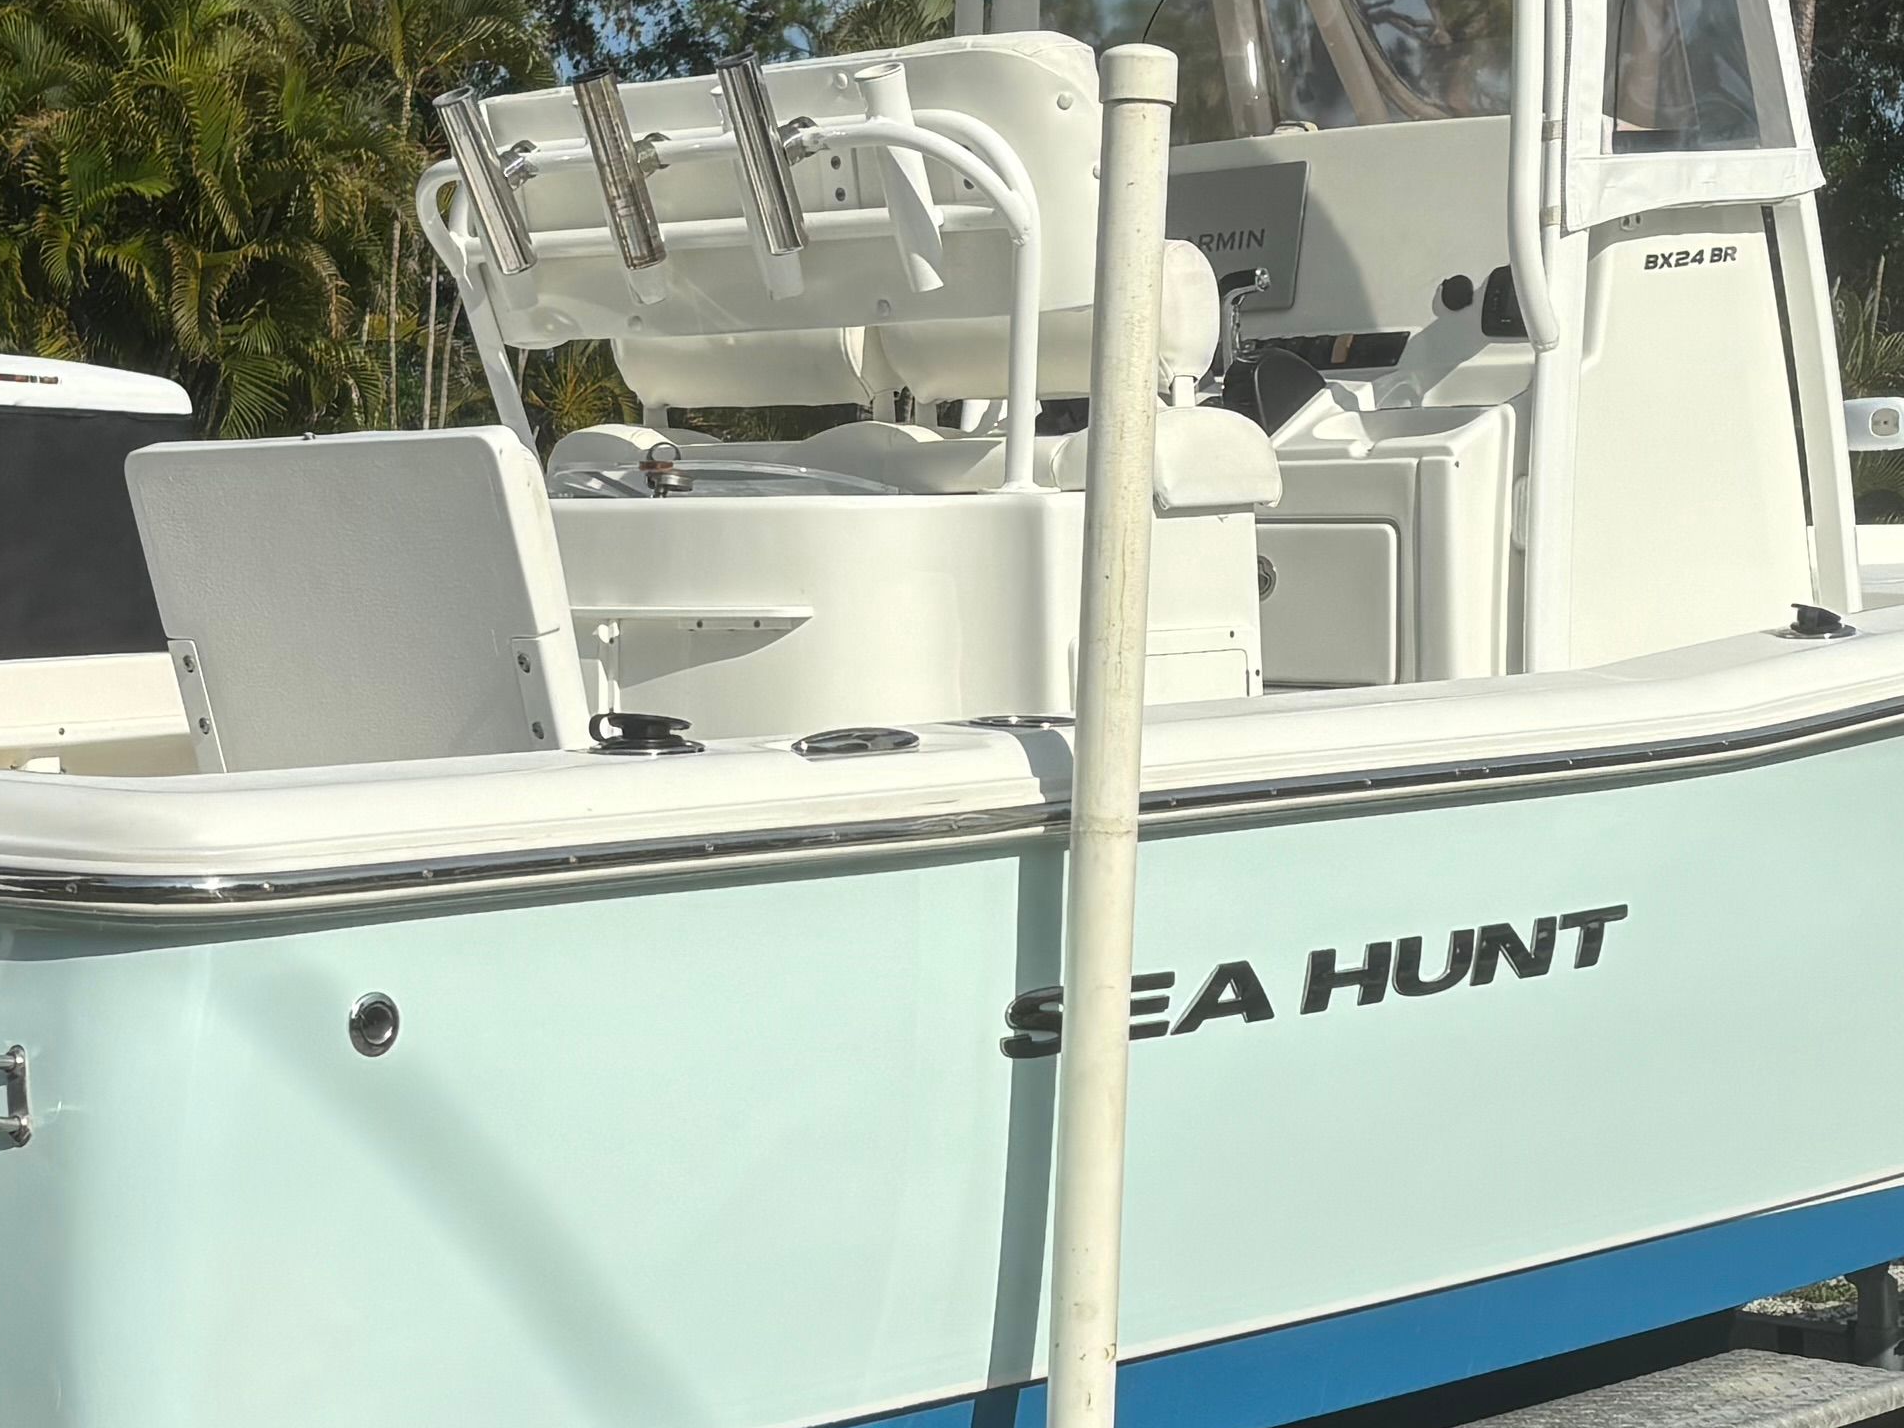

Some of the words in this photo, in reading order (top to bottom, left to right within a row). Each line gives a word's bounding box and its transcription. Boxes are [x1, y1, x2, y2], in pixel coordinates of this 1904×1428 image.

[1184, 228, 1266, 253] RMIN
[1644, 248, 1705, 270] BX24
[1709, 246, 1738, 263] BR
[1299, 903, 1629, 1016] HUNT
